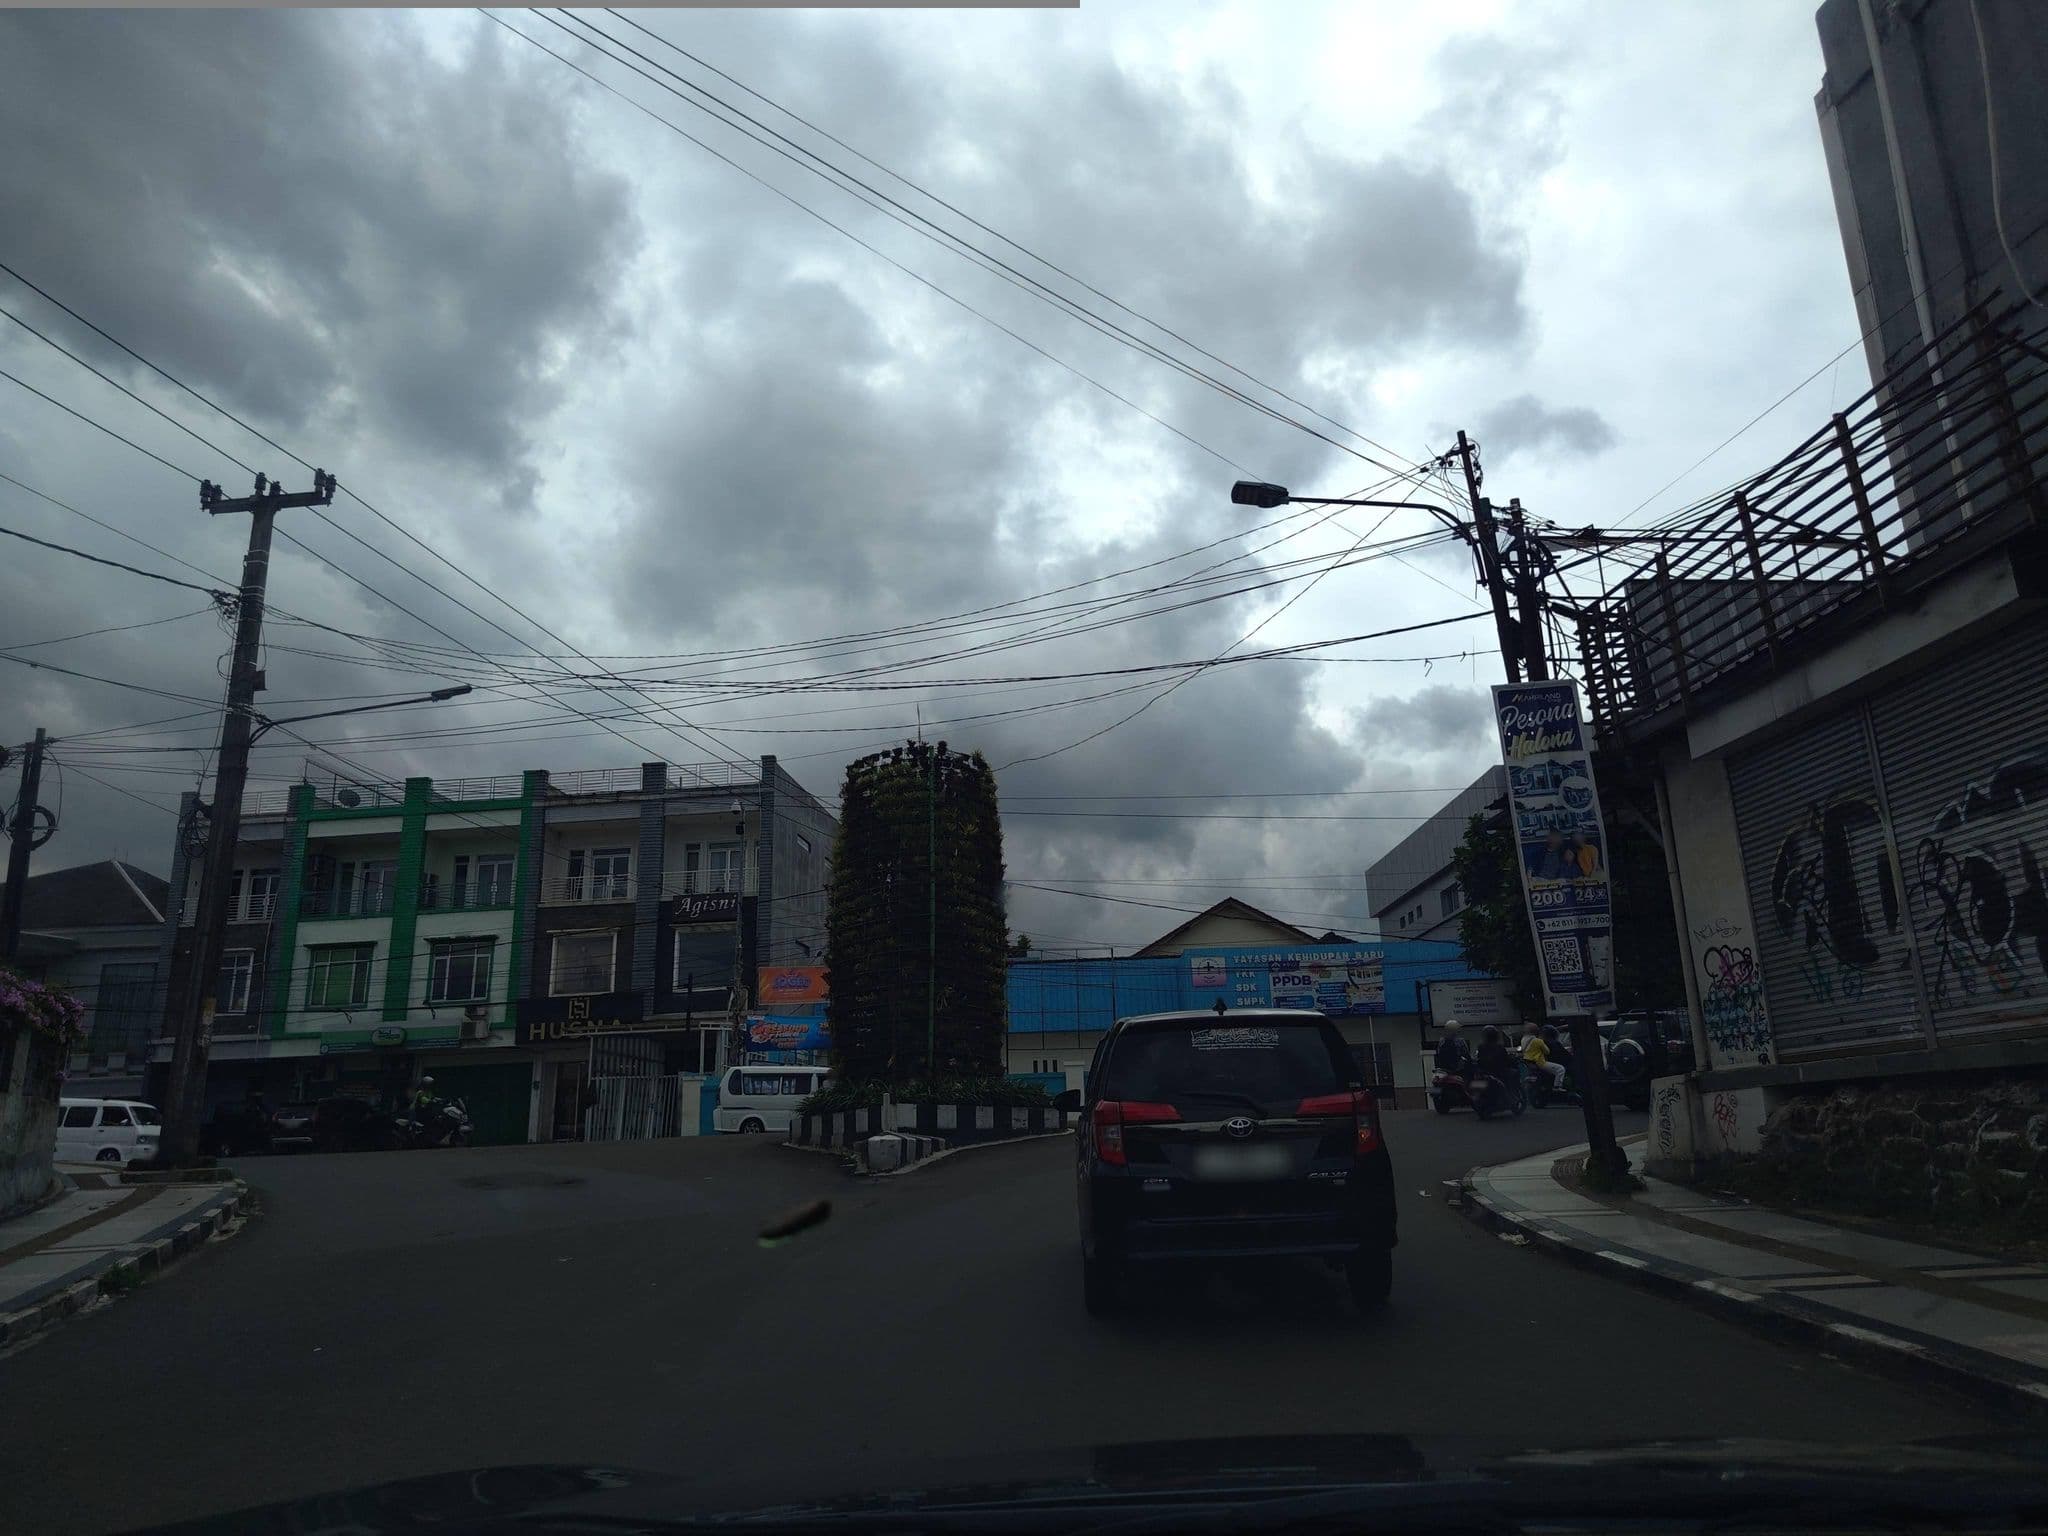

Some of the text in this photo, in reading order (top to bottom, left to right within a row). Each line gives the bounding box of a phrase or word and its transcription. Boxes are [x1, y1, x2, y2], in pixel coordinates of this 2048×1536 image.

[1500, 703, 1576, 735] Pesona
[1531, 890, 1564, 906] 200
[674, 894, 737, 918] Agisni
[1233, 950, 1384, 963] YAYASAN KEHIDUPAN BARU
[1235, 983, 1257, 992] SDK
[1272, 975, 1312, 987] PPDB
[1236, 996, 1265, 1006] SMPK
